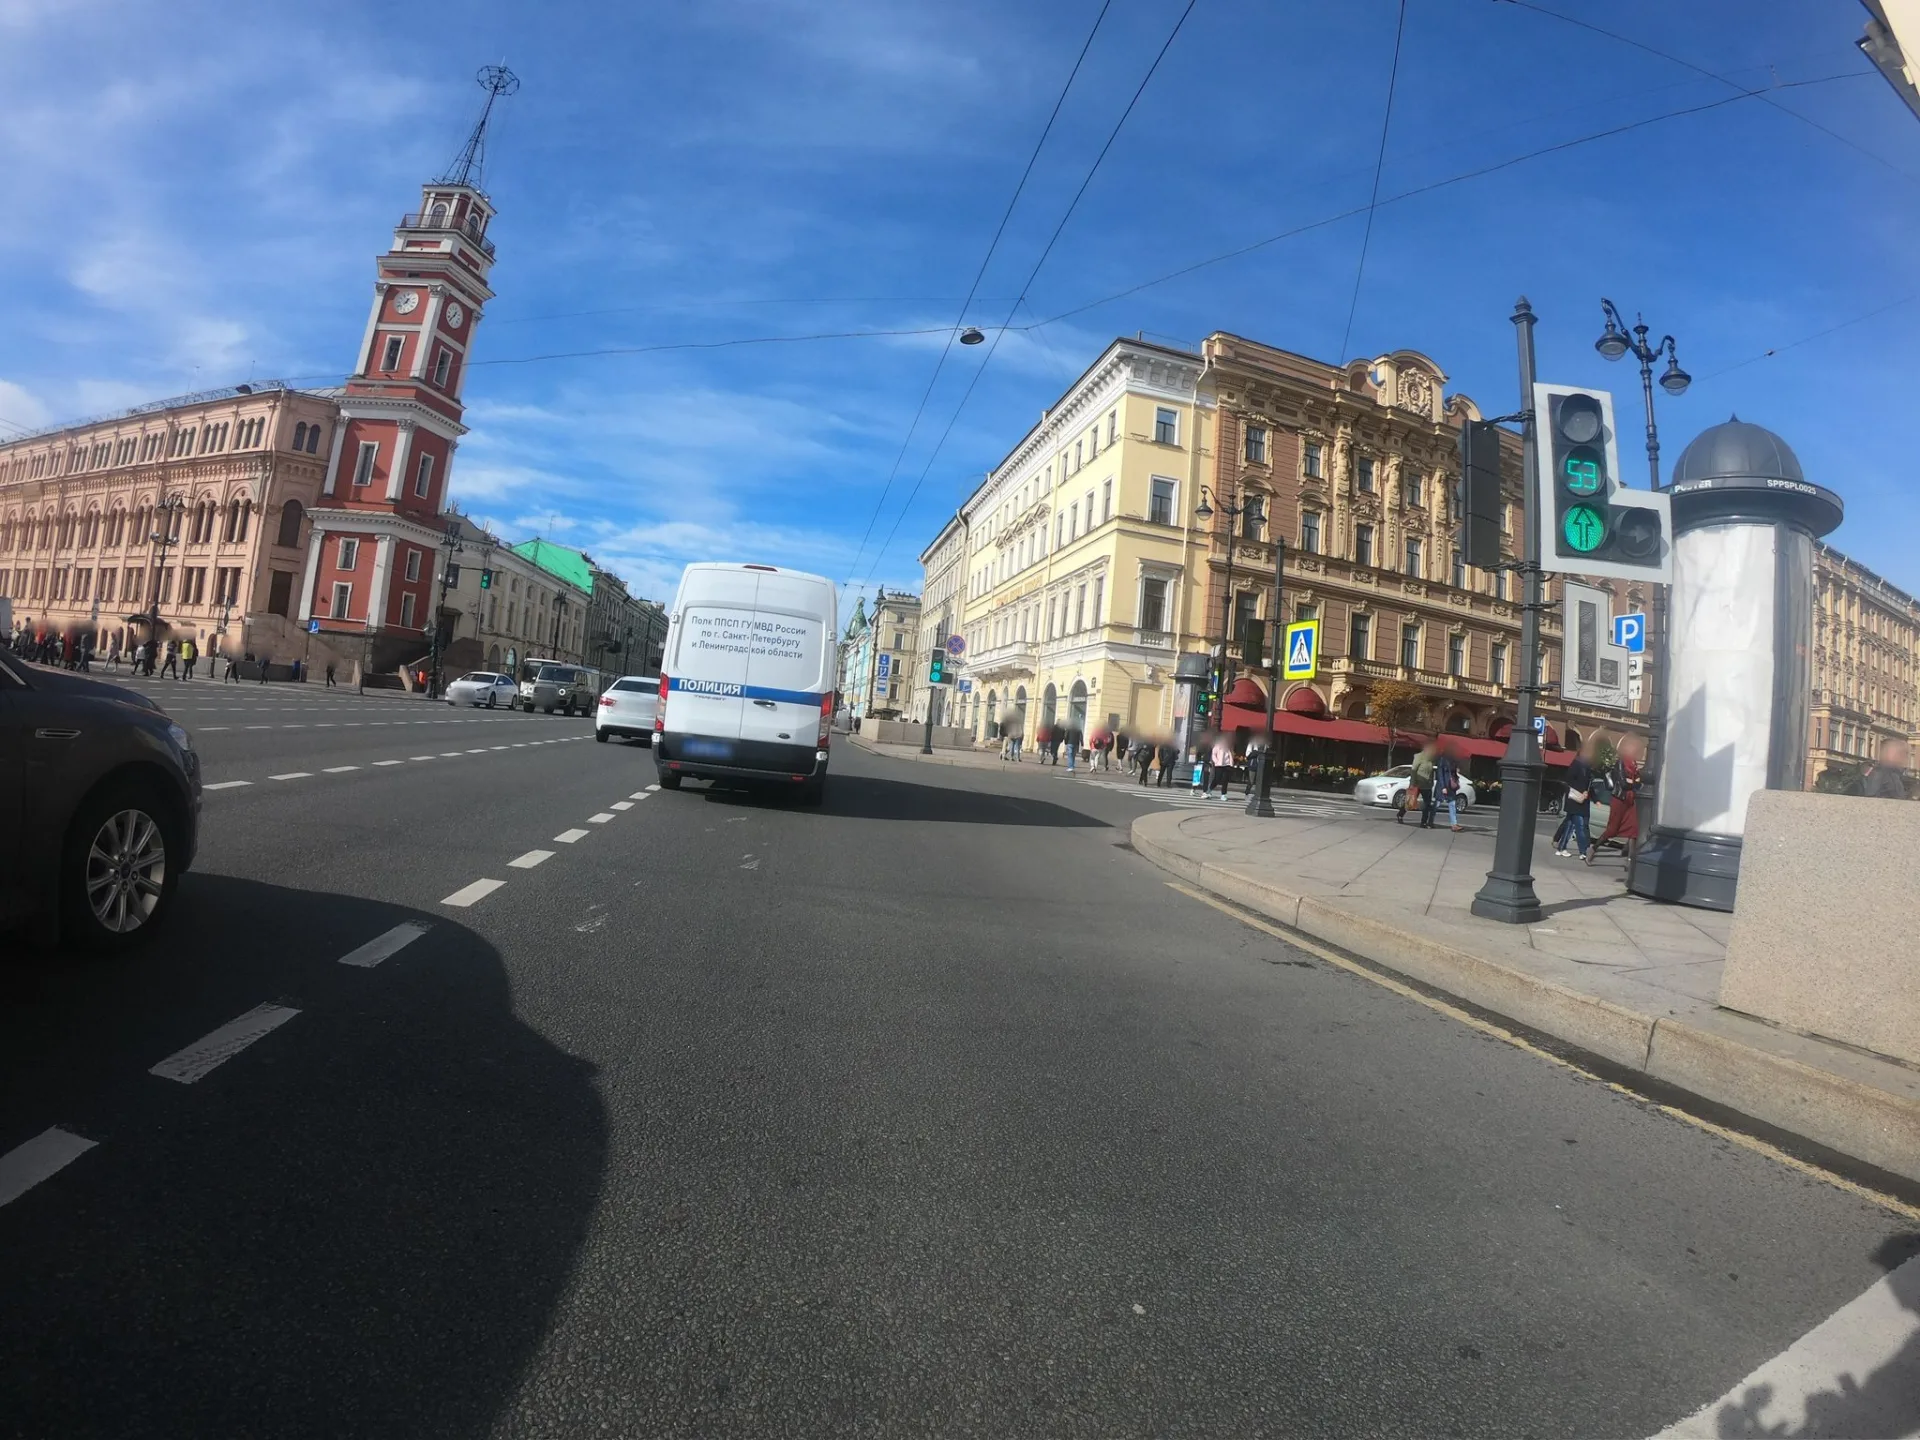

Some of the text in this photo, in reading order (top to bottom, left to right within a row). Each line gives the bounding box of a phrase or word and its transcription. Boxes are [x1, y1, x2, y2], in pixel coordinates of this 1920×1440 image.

[1567, 459, 1597, 490] 53
[1674, 480, 1712, 493] POER
[692, 616, 806, 635] Полк ППСП ГУ МВД России
[701, 630, 712, 638] по
[714, 631, 720, 639] г.
[1621, 619, 1639, 646] P
[699, 641, 766, 654] Ленинградской
[768, 648, 803, 659] области
[679, 679, 742, 696] ПОЛИЦИЯ
